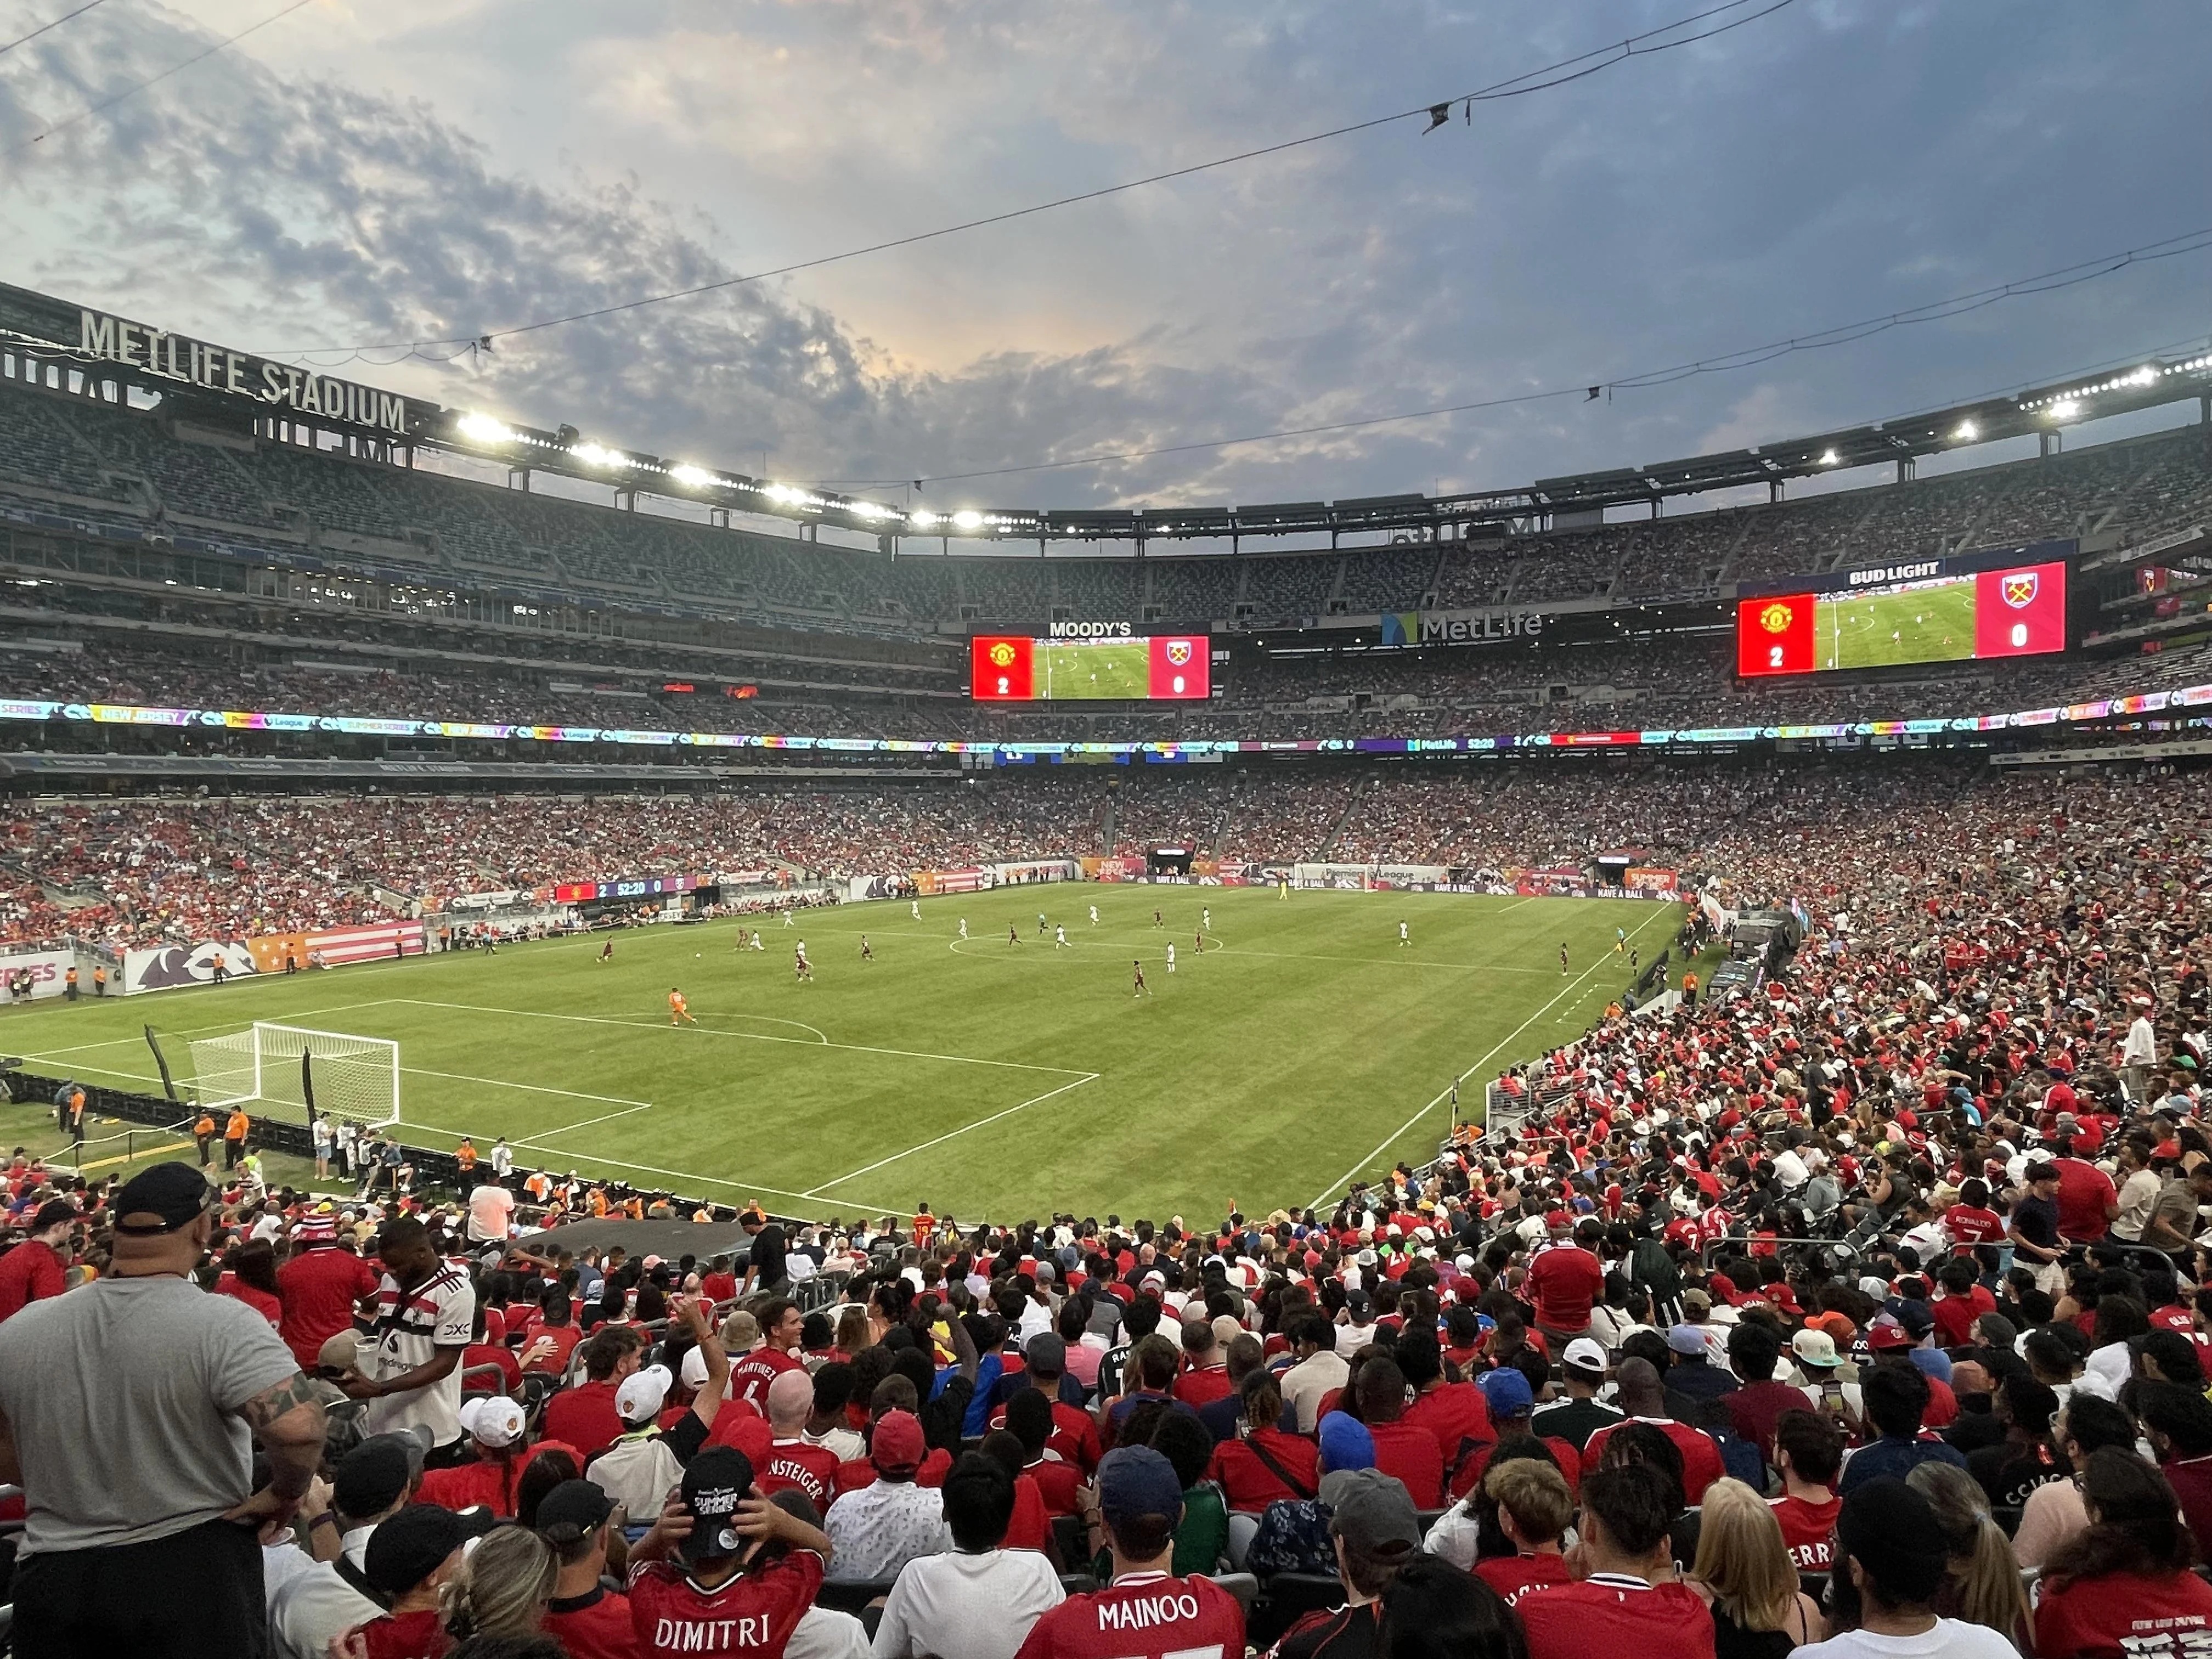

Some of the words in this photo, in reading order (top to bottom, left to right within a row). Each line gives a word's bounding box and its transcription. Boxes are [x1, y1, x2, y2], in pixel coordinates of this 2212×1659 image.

[80, 310, 247, 394] METLIFE
[262, 363, 407, 433] STADIUM
[1850, 567, 1885, 585] BUD
[1887, 561, 1939, 580] LIGHT
[1050, 622, 1131, 636] MOODY'S
[1422, 611, 1542, 641] MetLife
[2011, 623, 2027, 647] 0
[1770, 647, 1784, 667] 2
[997, 677, 1008, 694] 2
[1173, 676, 1185, 693] 0
[2, 704, 41, 714] SERIES
[101, 708, 131, 720] NEW
[132, 710, 179, 723] JERSEY
[274, 718, 303, 727] League
[1421, 739, 1457, 749] MetLife
[1467, 738, 1495, 748] 52:20
[1514, 736, 1521, 746] 2
[1101, 860, 1125, 869] NEW
[1326, 867, 1362, 878] Premie
[1378, 869, 1414, 880] League
[598, 884, 607, 898] 2
[618, 881, 645, 896] 52:20
[654, 879, 662, 893] 0
[1435, 883, 1451, 892] HAVE
[1452, 883, 1457, 892] A
[1459, 883, 1476, 893] BALL
[1598, 889, 1617, 898] HAVE
[1618, 889, 1624, 898] A
[1625, 889, 1644, 899] BALL
[1688, 1233, 1697, 1250] 7
[1963, 1228, 1983, 1243] 7
[737, 1362, 776, 1381] MARTINEZ
[695, 1492, 737, 1506] SUMMER
[699, 1504, 734, 1515] SERIES
[1098, 1594, 1198, 1631] MAINOO
[654, 1613, 769, 1651] DIMITRI
